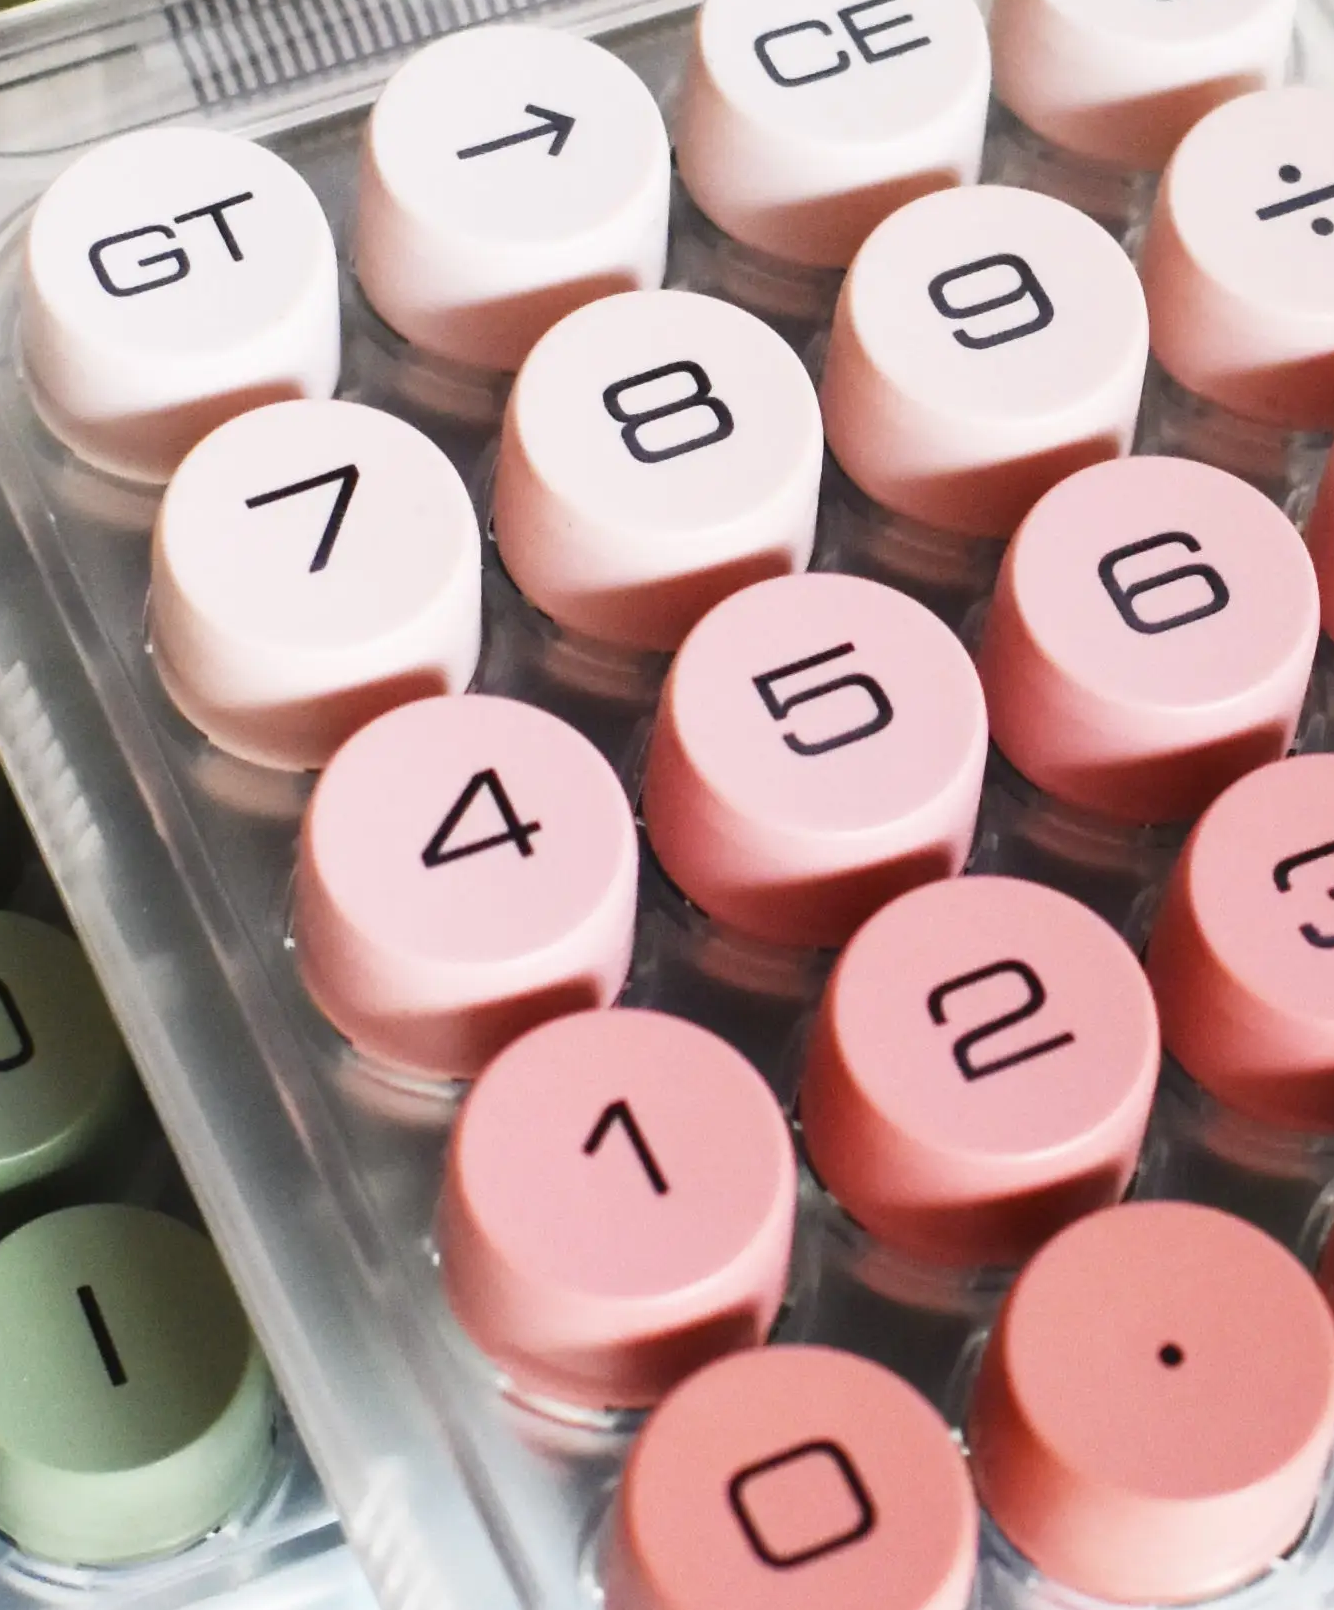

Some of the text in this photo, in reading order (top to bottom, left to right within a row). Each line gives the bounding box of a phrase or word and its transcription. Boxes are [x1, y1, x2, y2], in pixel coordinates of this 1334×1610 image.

[89, 192, 253, 296] GT
[928, 254, 1054, 349] 9
[603, 361, 734, 463] 8
[246, 465, 359, 572] 7
[1098, 532, 1229, 634] 6
[753, 643, 893, 755] 5
[422, 769, 540, 867] 4
[928, 960, 1074, 1081] 2
[584, 1100, 668, 1194] 1
[728, 1440, 876, 1569] 0
